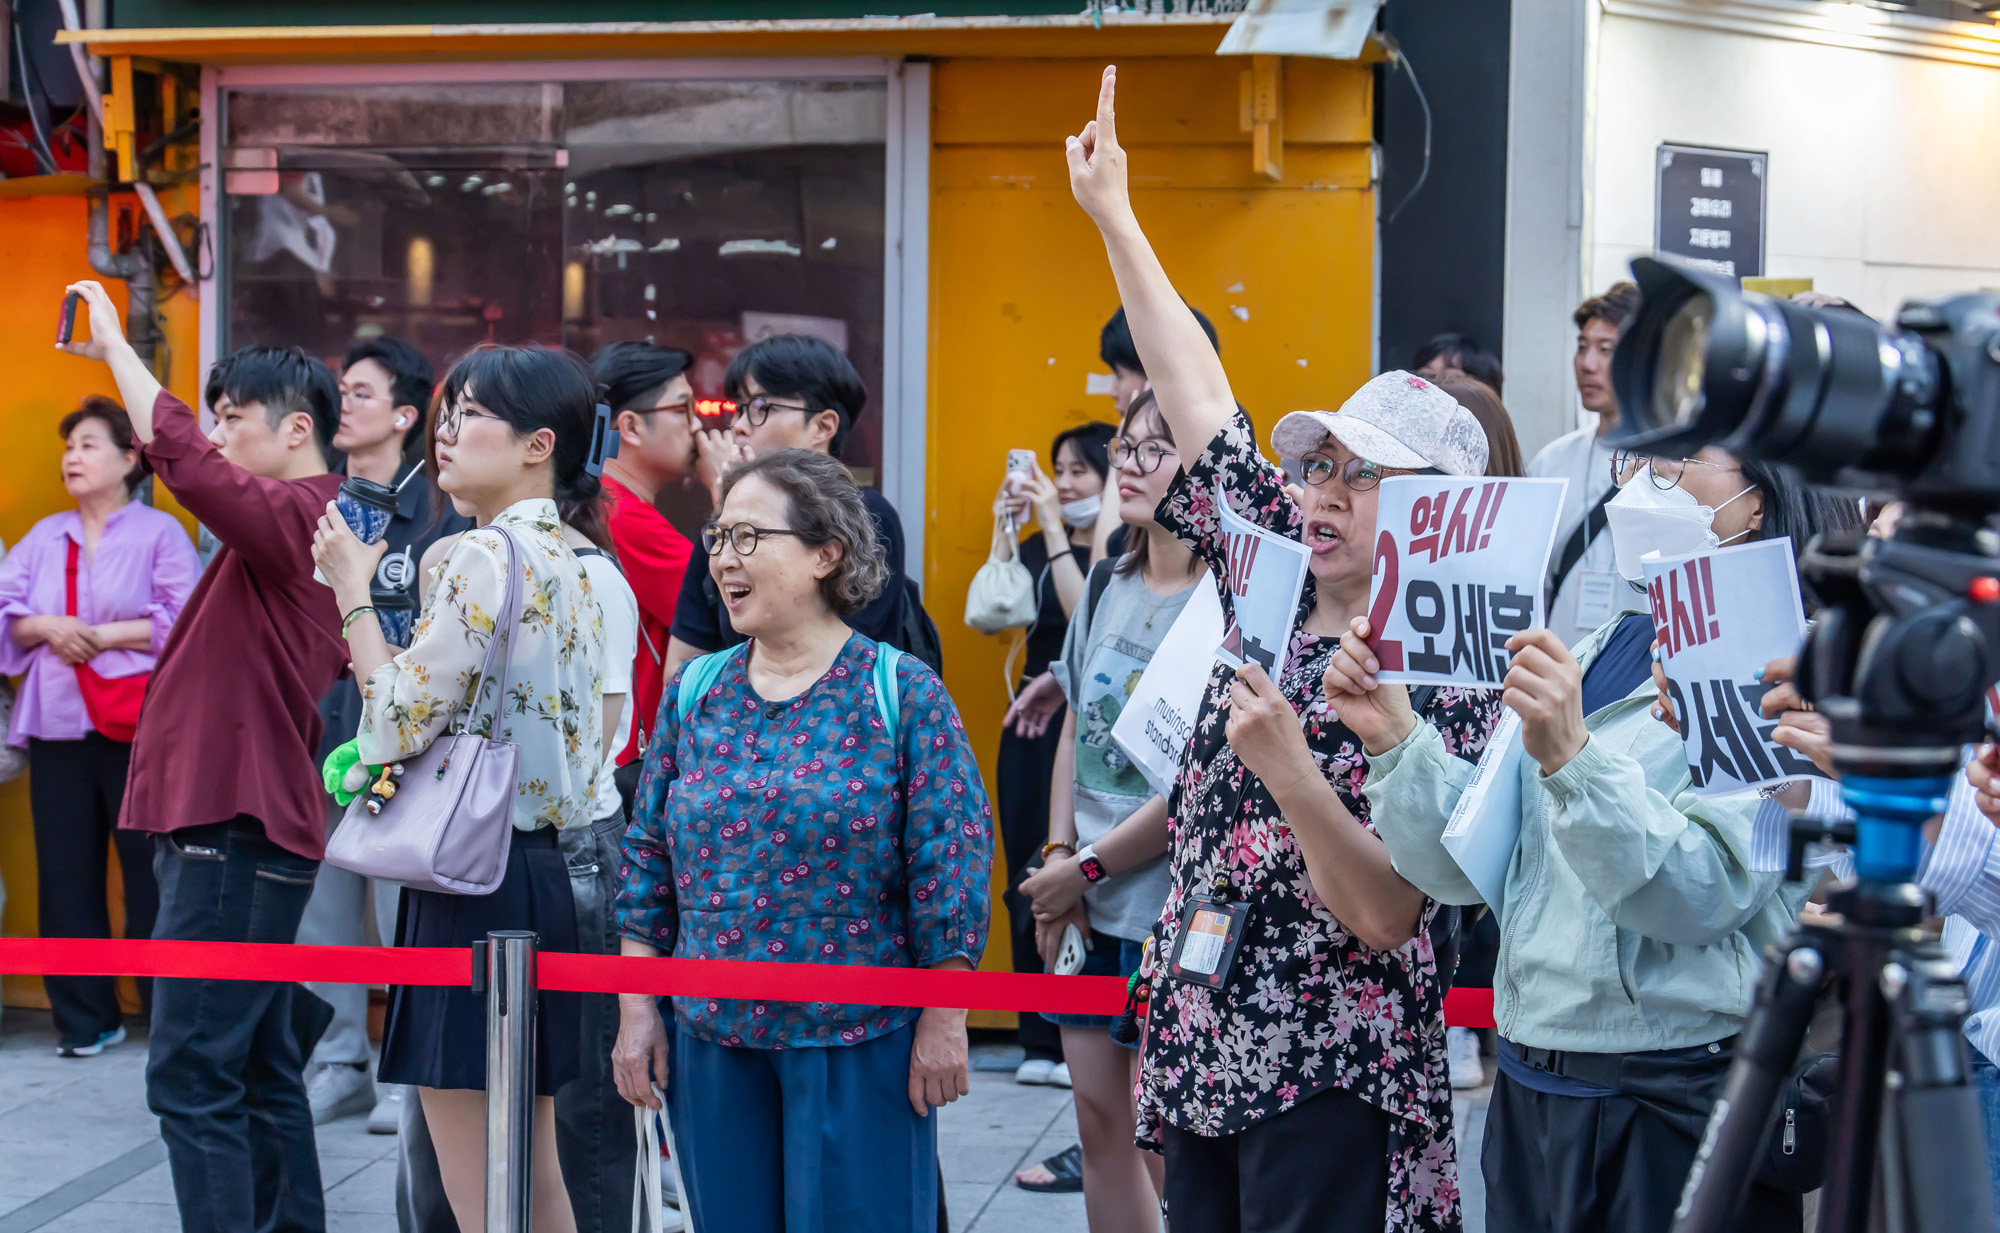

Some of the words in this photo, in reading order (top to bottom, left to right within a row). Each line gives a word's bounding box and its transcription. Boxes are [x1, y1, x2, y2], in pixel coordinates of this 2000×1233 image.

[1225, 532, 1260, 598] 시!
[1364, 530, 1404, 672] 2
[1405, 579, 1534, 683] 오세훈
